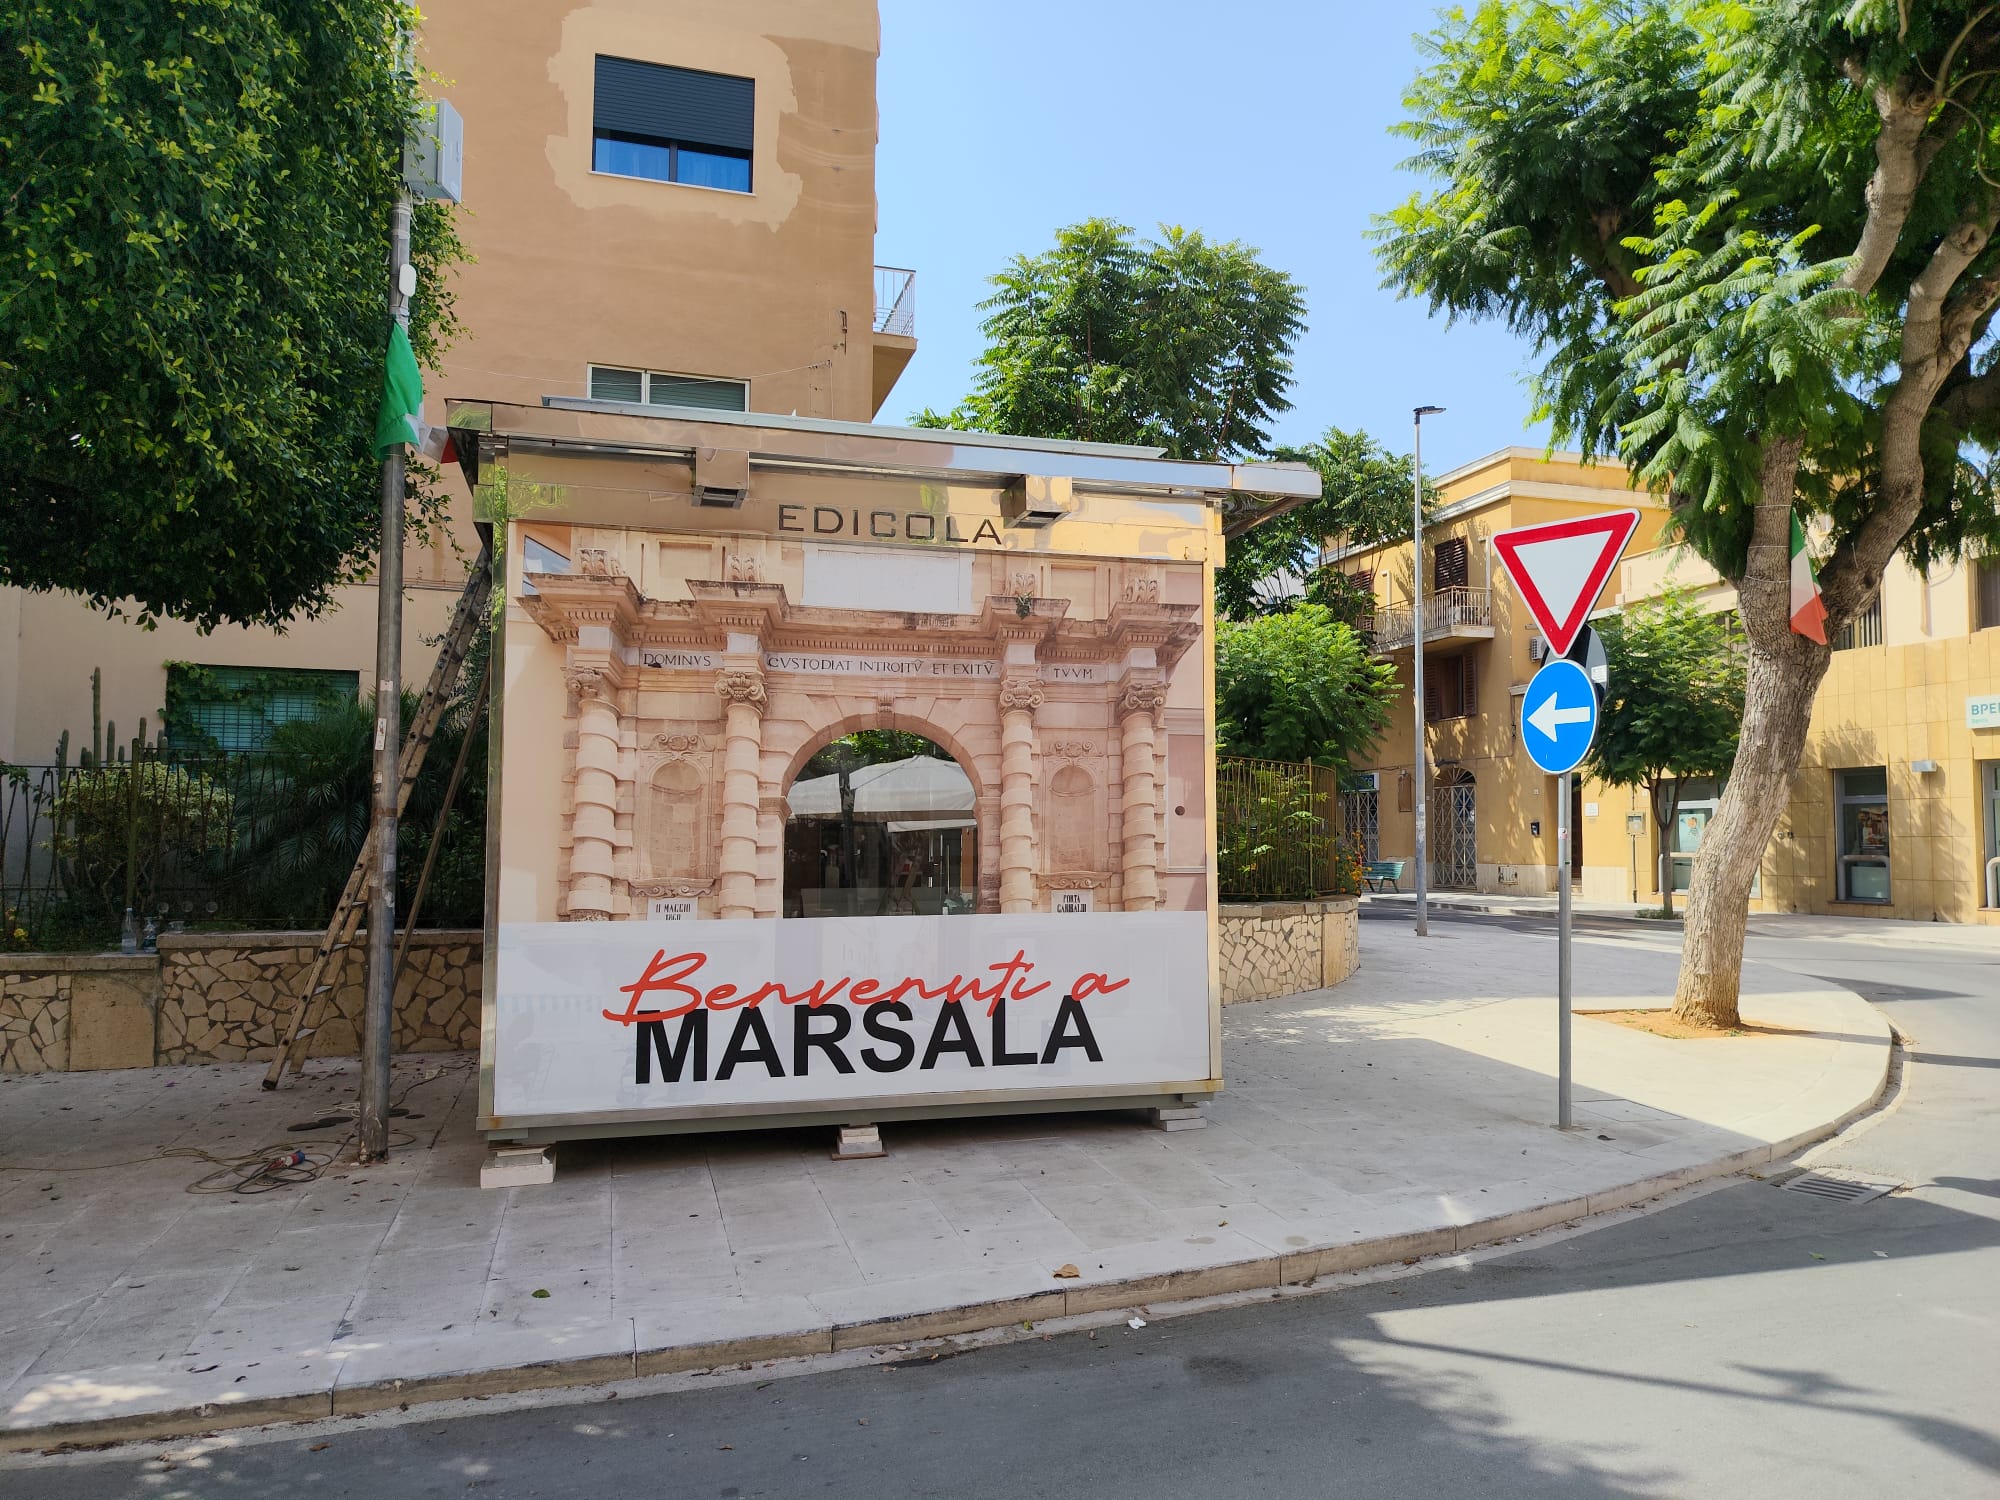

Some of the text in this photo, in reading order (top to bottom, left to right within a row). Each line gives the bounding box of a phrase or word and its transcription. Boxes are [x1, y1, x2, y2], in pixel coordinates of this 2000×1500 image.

[778, 504, 1002, 545] EDICOLA
[643, 653, 712, 667] DOMINVS
[767, 657, 853, 671] CVSTODIAT
[932, 663, 950, 675] ET
[1053, 667, 1093, 680] TVVM
[1971, 702, 2000, 715] BPE
[602, 949, 1131, 1026] Benvenuti a
[635, 994, 1104, 1085] MARSALA
